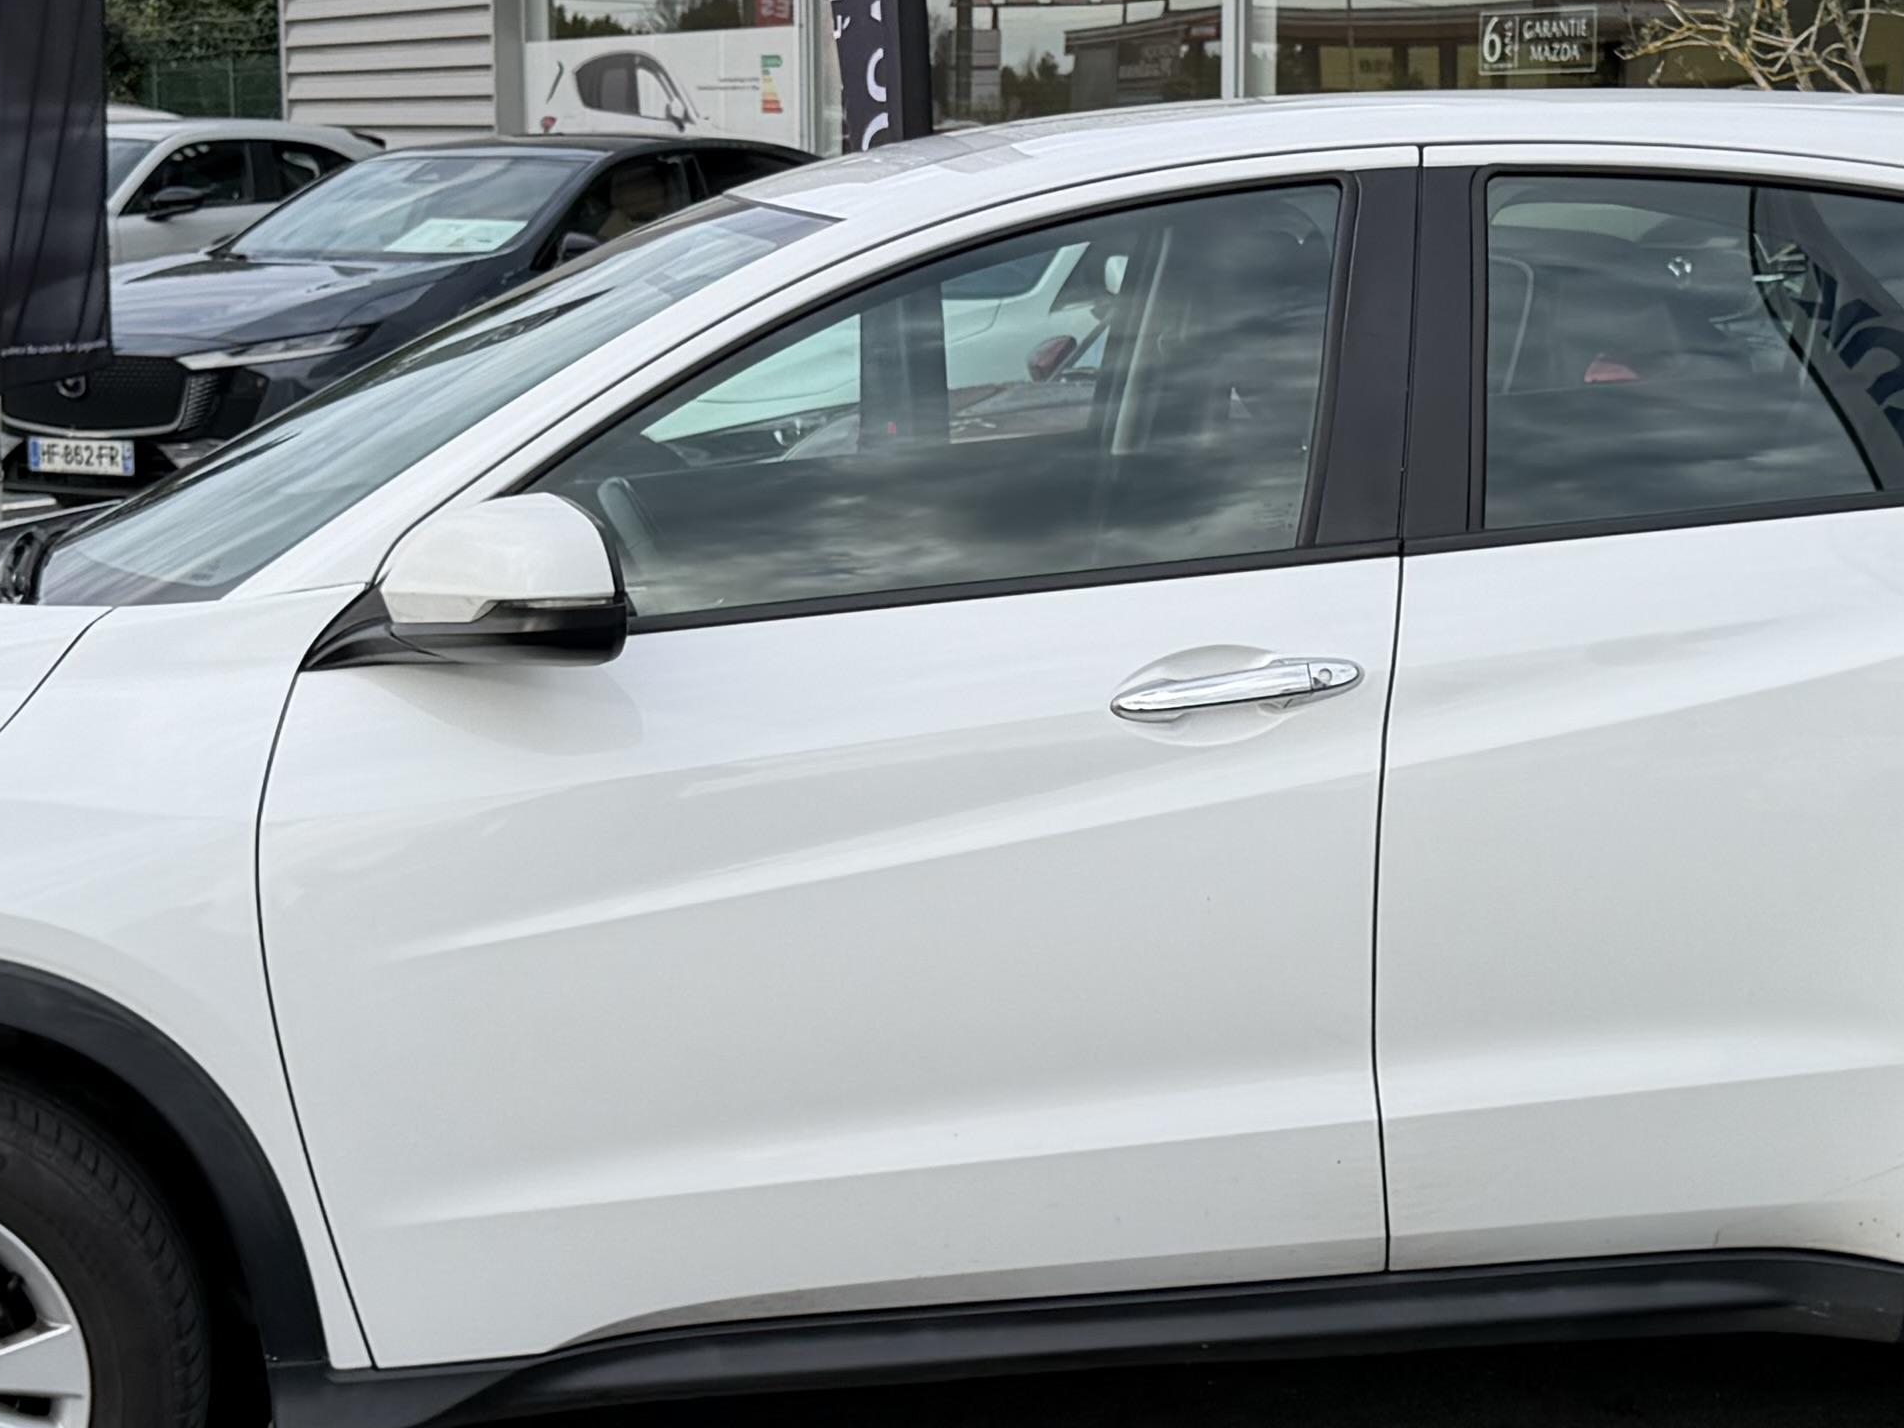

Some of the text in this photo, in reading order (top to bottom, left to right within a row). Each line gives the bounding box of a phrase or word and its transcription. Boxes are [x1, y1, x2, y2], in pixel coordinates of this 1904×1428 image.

[1482, 16, 1502, 63] 6
[1522, 17, 1589, 40] GARANTIE
[1529, 42, 1581, 62] MAZDA
